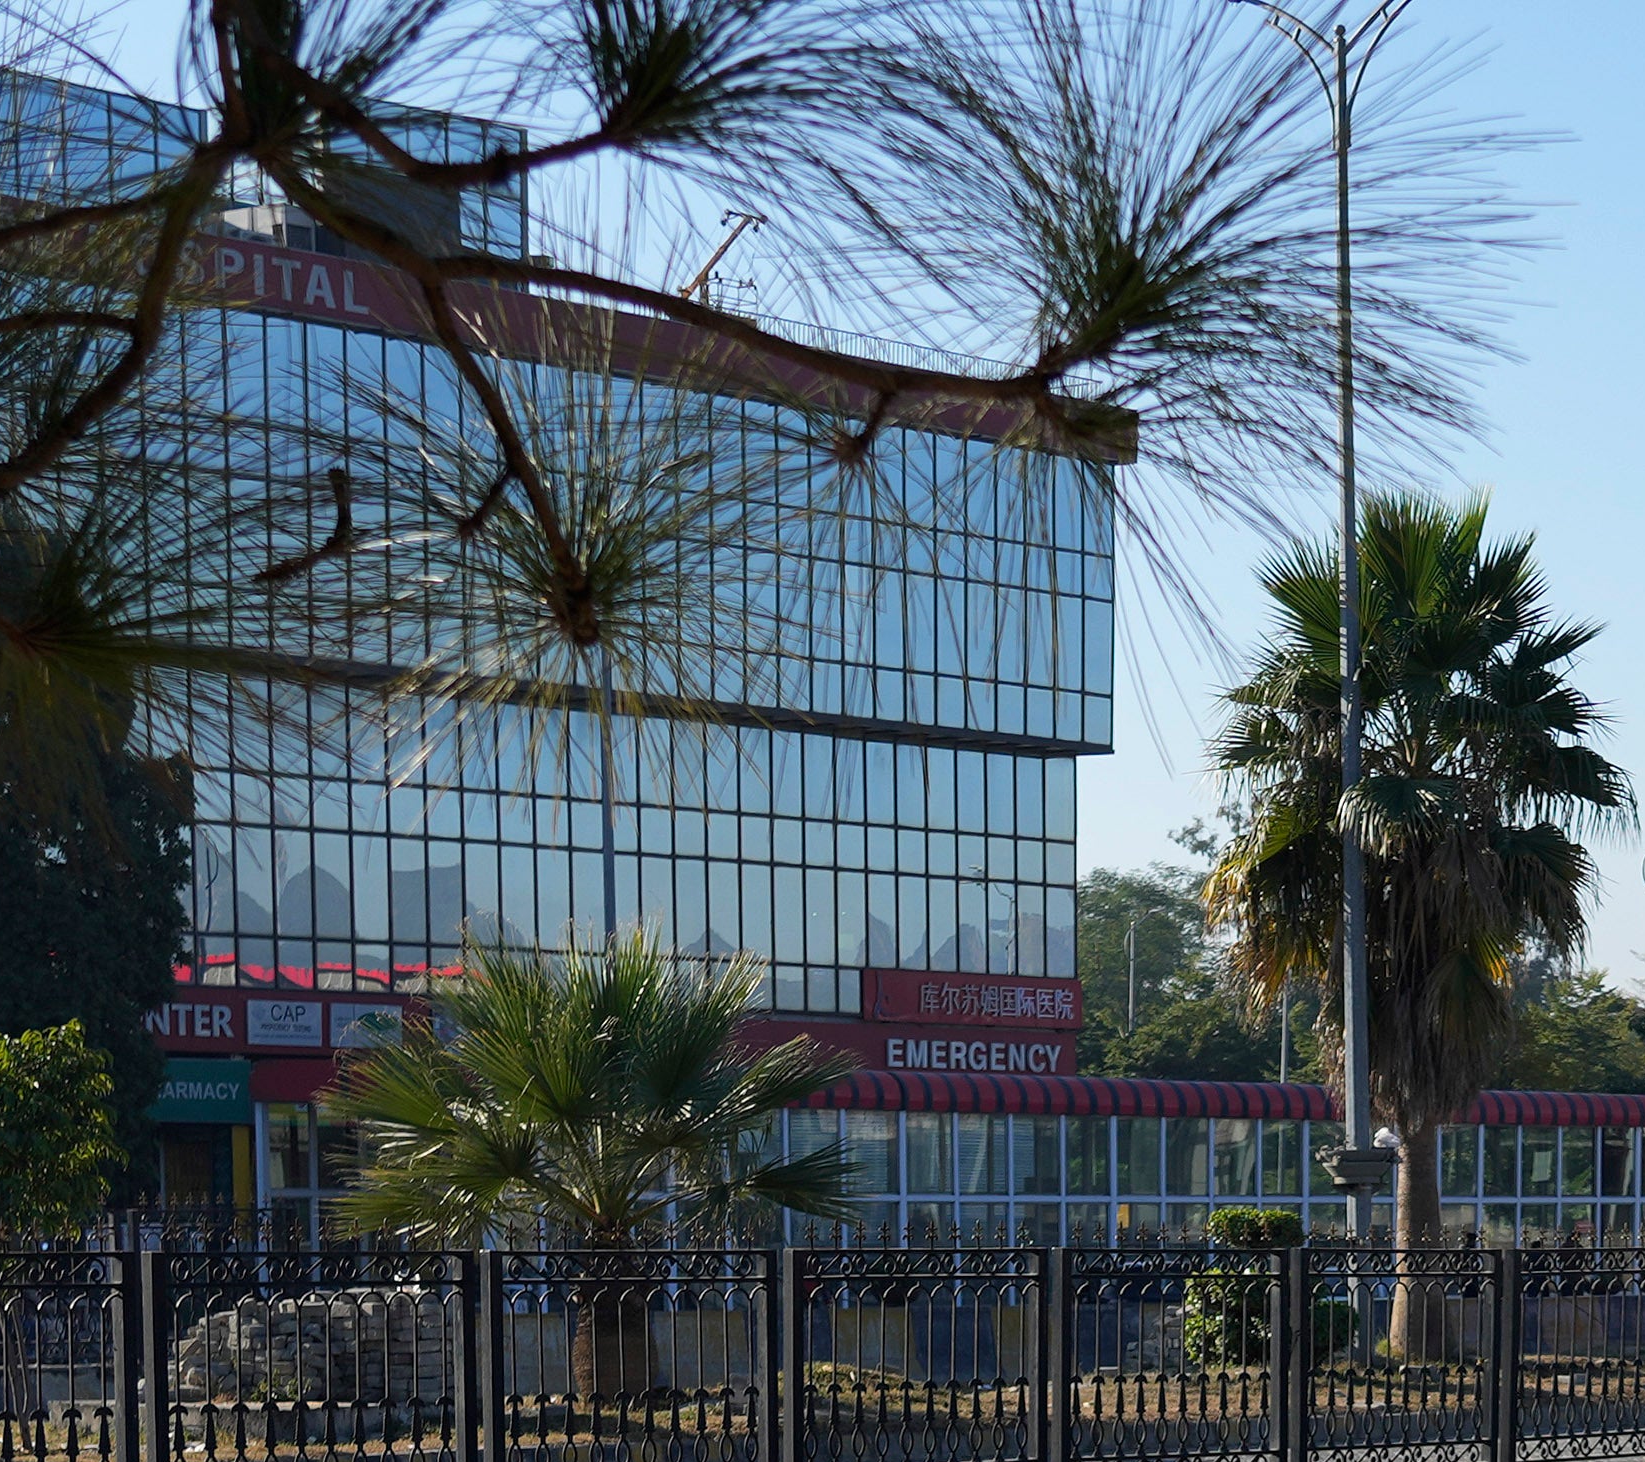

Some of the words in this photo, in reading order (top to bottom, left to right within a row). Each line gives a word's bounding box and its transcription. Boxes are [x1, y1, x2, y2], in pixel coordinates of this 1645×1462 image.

[176, 240, 370, 316] SPITAL
[269, 1003, 306, 1023] CAP
[919, 981, 1075, 1021] 库尔苏姆国际医院
[143, 1002, 235, 1038] NTER
[886, 1037, 1062, 1074] EMERGENCY
[158, 1081, 240, 1101] ARMACY
